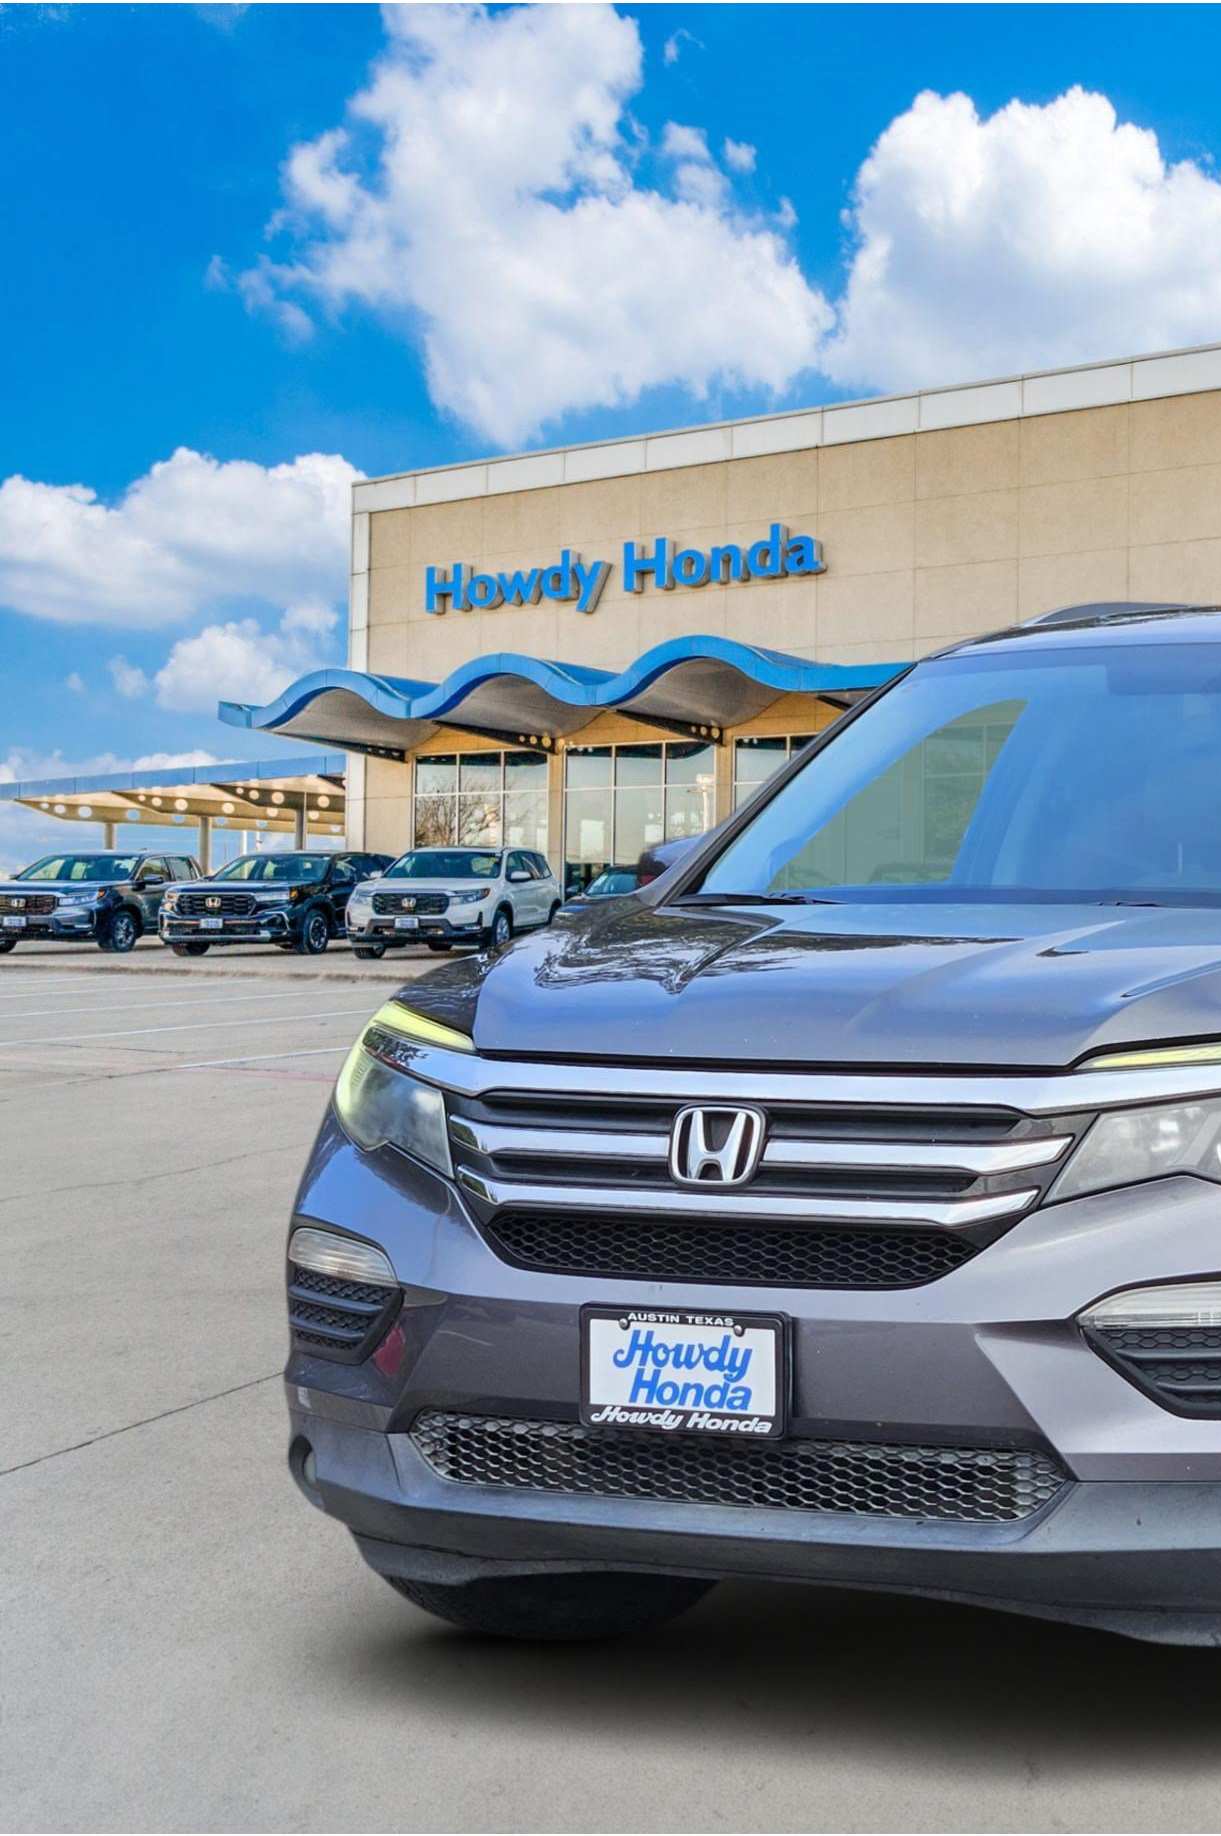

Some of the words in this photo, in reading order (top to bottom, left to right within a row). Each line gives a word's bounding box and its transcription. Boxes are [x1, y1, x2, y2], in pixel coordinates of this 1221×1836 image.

[425, 549, 612, 614] Howdy
[622, 523, 827, 593] Honda
[627, 1312, 680, 1324] AUSTIN
[685, 1315, 734, 1327] TEXAS
[612, 1329, 753, 1383] Howdy
[628, 1368, 753, 1411] Honda
[590, 1406, 684, 1430] Howdy
[686, 1412, 773, 1434] Honda
